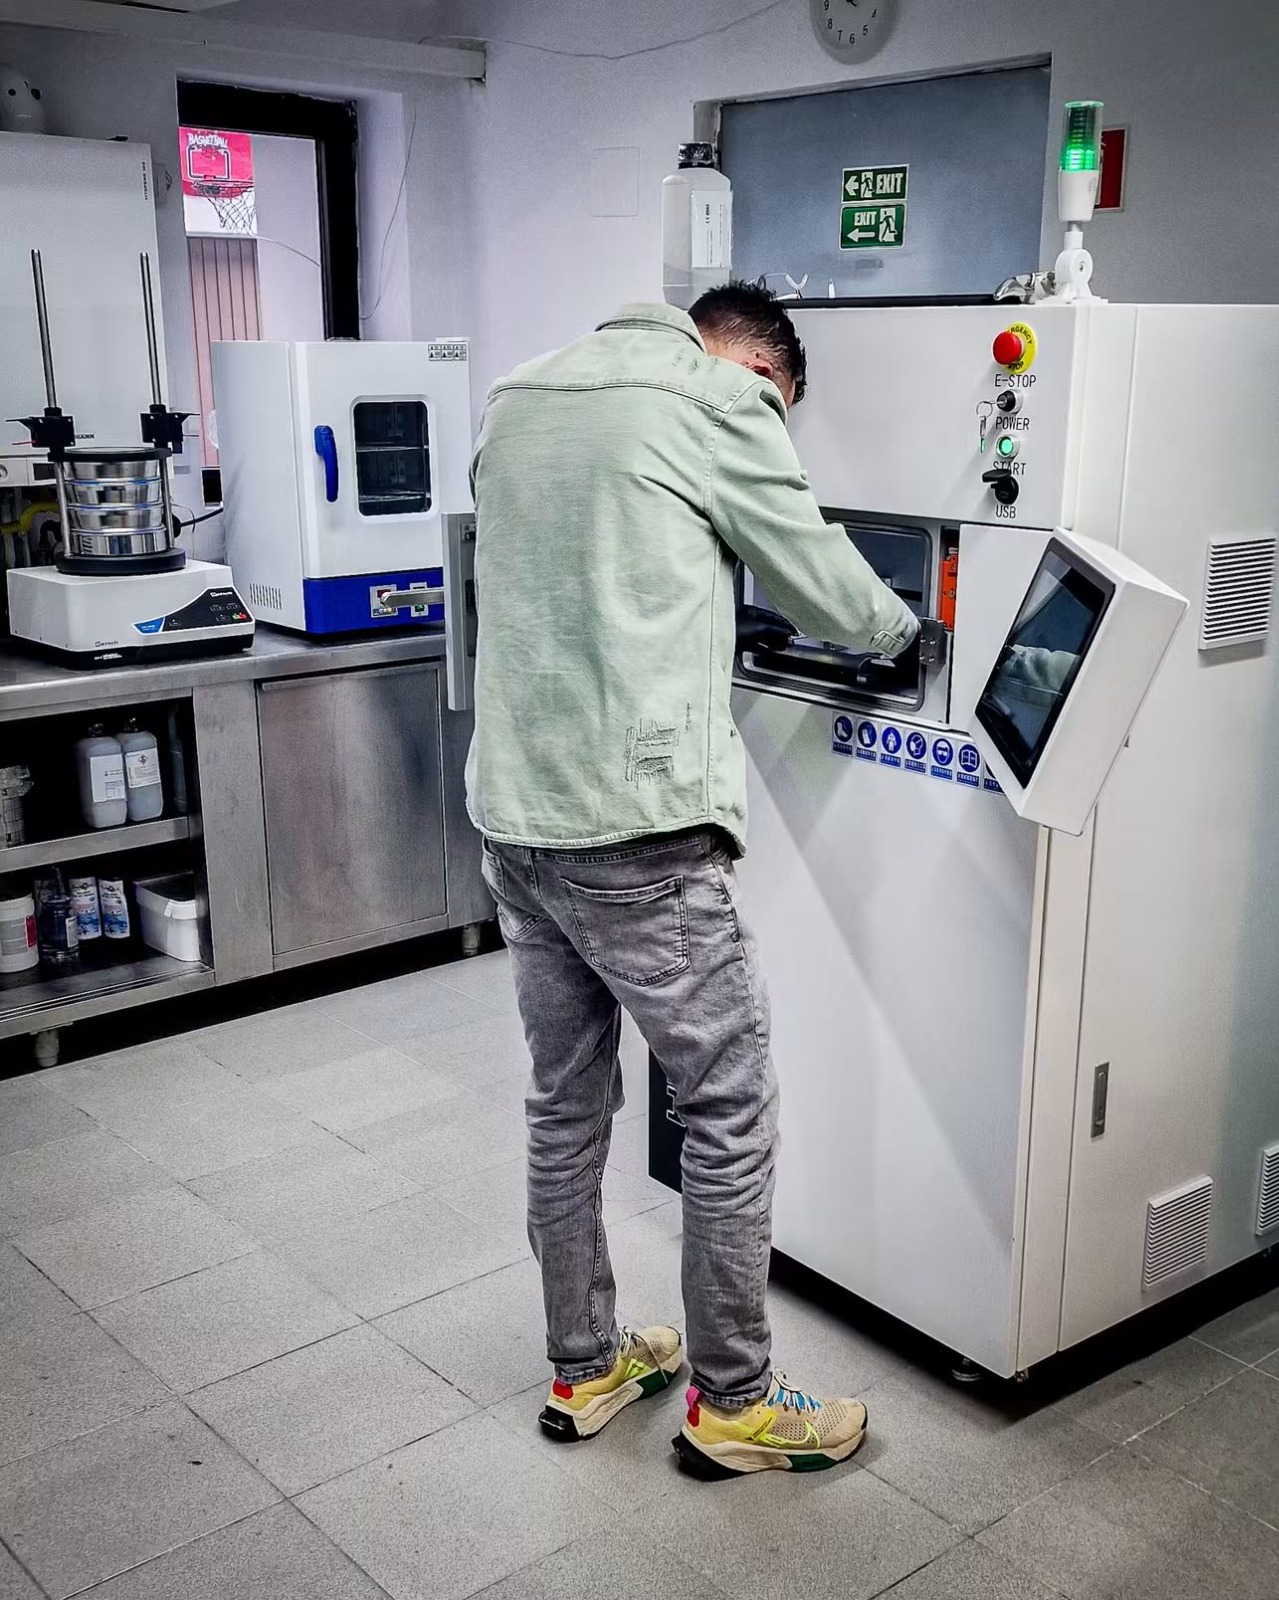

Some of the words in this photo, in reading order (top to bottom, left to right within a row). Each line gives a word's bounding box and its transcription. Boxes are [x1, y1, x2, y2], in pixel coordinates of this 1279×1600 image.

[827, 18, 833, 30] 8
[862, 24, 869, 36] 5
[837, 30, 843, 41] 7
[849, 33, 855, 44] 6
[187, 133, 228, 148] BASKETBALL
[876, 172, 904, 194] EXIT
[854, 211, 877, 226] EXIT
[1009, 325, 1034, 344] RGENCY
[994, 373, 1037, 388] E-STOP
[995, 416, 1030, 431] POWER
[995, 505, 1017, 519] USB
